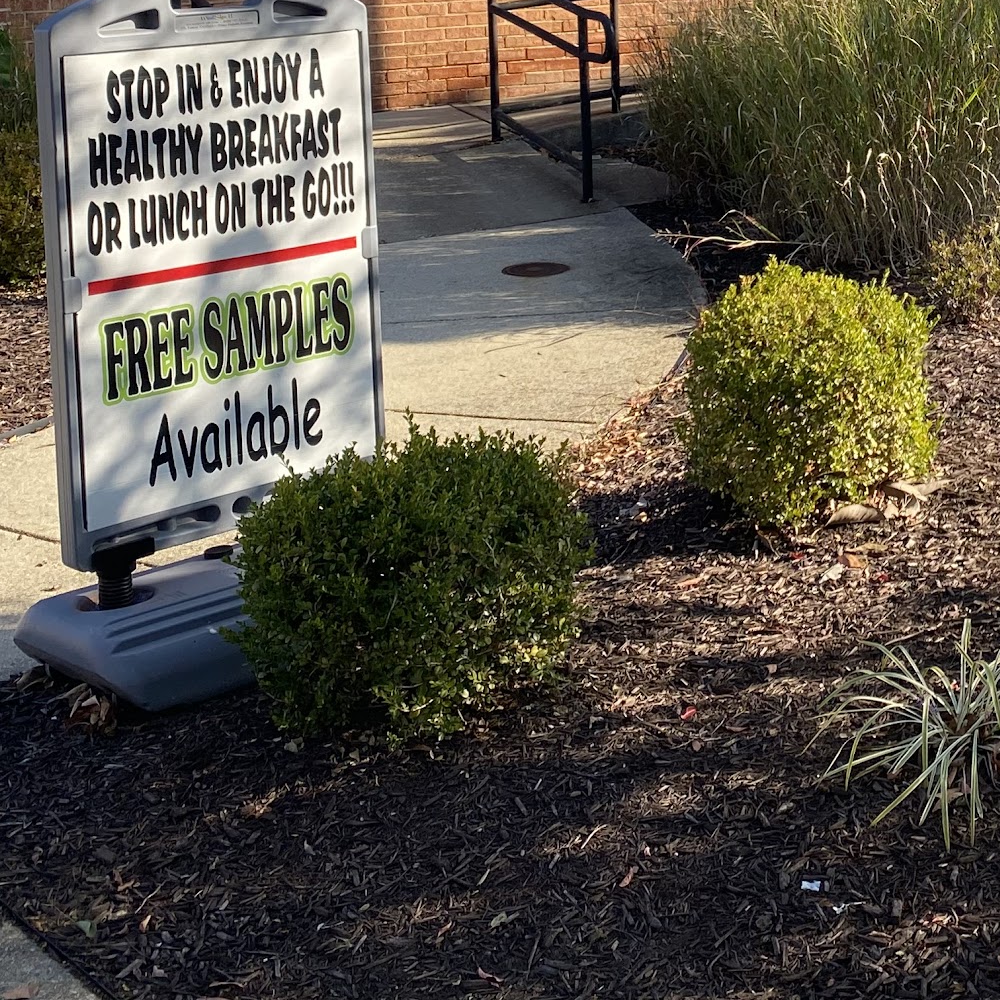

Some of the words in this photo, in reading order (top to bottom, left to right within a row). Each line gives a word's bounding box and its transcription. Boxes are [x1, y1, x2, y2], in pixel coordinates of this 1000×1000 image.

[106, 65, 170, 124] STOP
[175, 62, 203, 115] IN
[209, 62, 223, 109] &
[227, 51, 302, 109] ENJOY
[308, 47, 325, 99] A
[88, 122, 204, 189] HEALTHY
[209, 107, 342, 173] BREAKFAST
[87, 200, 122, 256] OR
[127, 184, 208, 249] LUNCH
[214, 181, 246, 235] ON
[252, 173, 296, 228] THE
[302, 160, 355, 219] GO!!!
[102, 306, 195, 402] FREE
[202, 276, 351, 381] SAMPLES
[149, 377, 324, 487] Available
